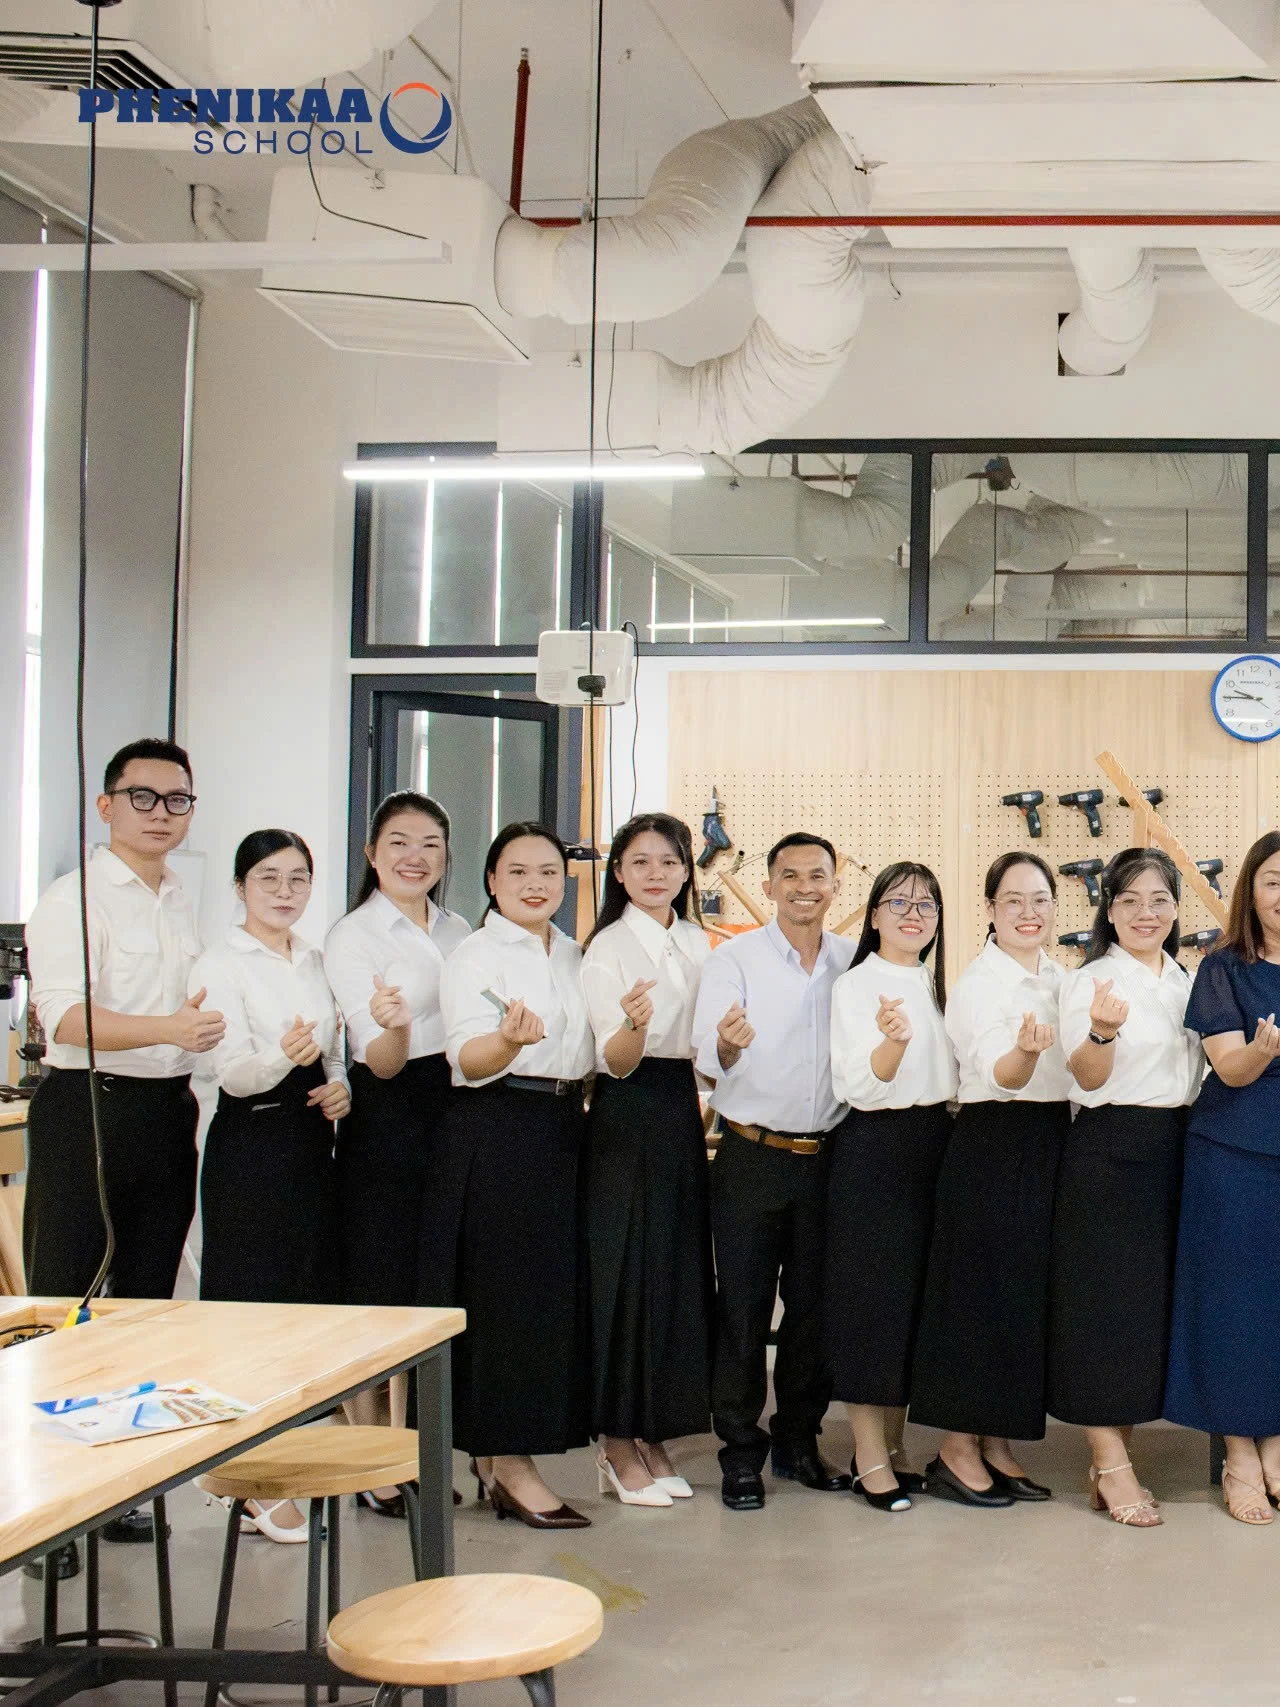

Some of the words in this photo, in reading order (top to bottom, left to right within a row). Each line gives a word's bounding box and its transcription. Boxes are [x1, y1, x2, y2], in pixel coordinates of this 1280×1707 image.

[1237, 669, 1245, 677] 11
[1250, 665, 1260, 673] 12
[1268, 669, 1272, 677] 1
[1225, 680, 1236, 688] 10
[1225, 709, 1235, 717] 8
[1250, 723, 1259, 732] 6
